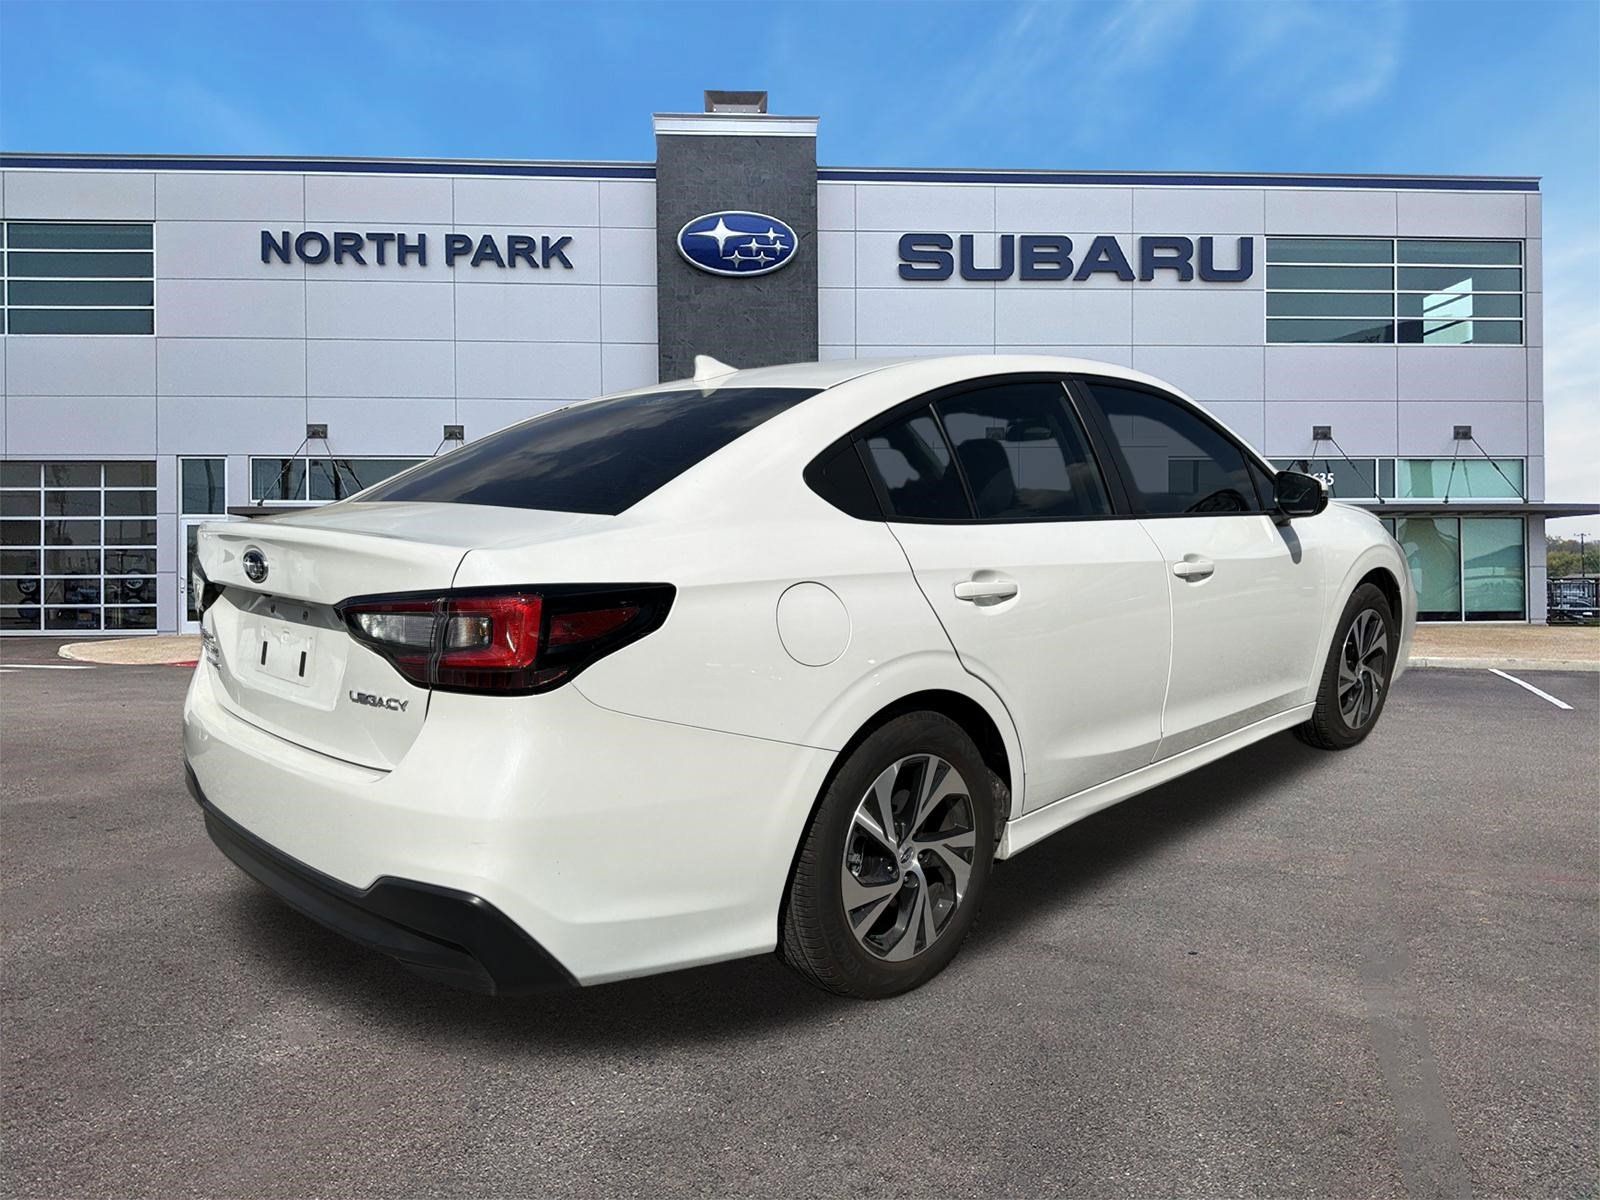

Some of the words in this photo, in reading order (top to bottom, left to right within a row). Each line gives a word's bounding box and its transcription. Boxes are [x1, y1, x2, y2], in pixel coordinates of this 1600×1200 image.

[261, 230, 427, 267] NORTH
[444, 232, 574, 269] PARK
[897, 233, 1255, 283] SUBARU
[349, 690, 409, 712] LEGACY
